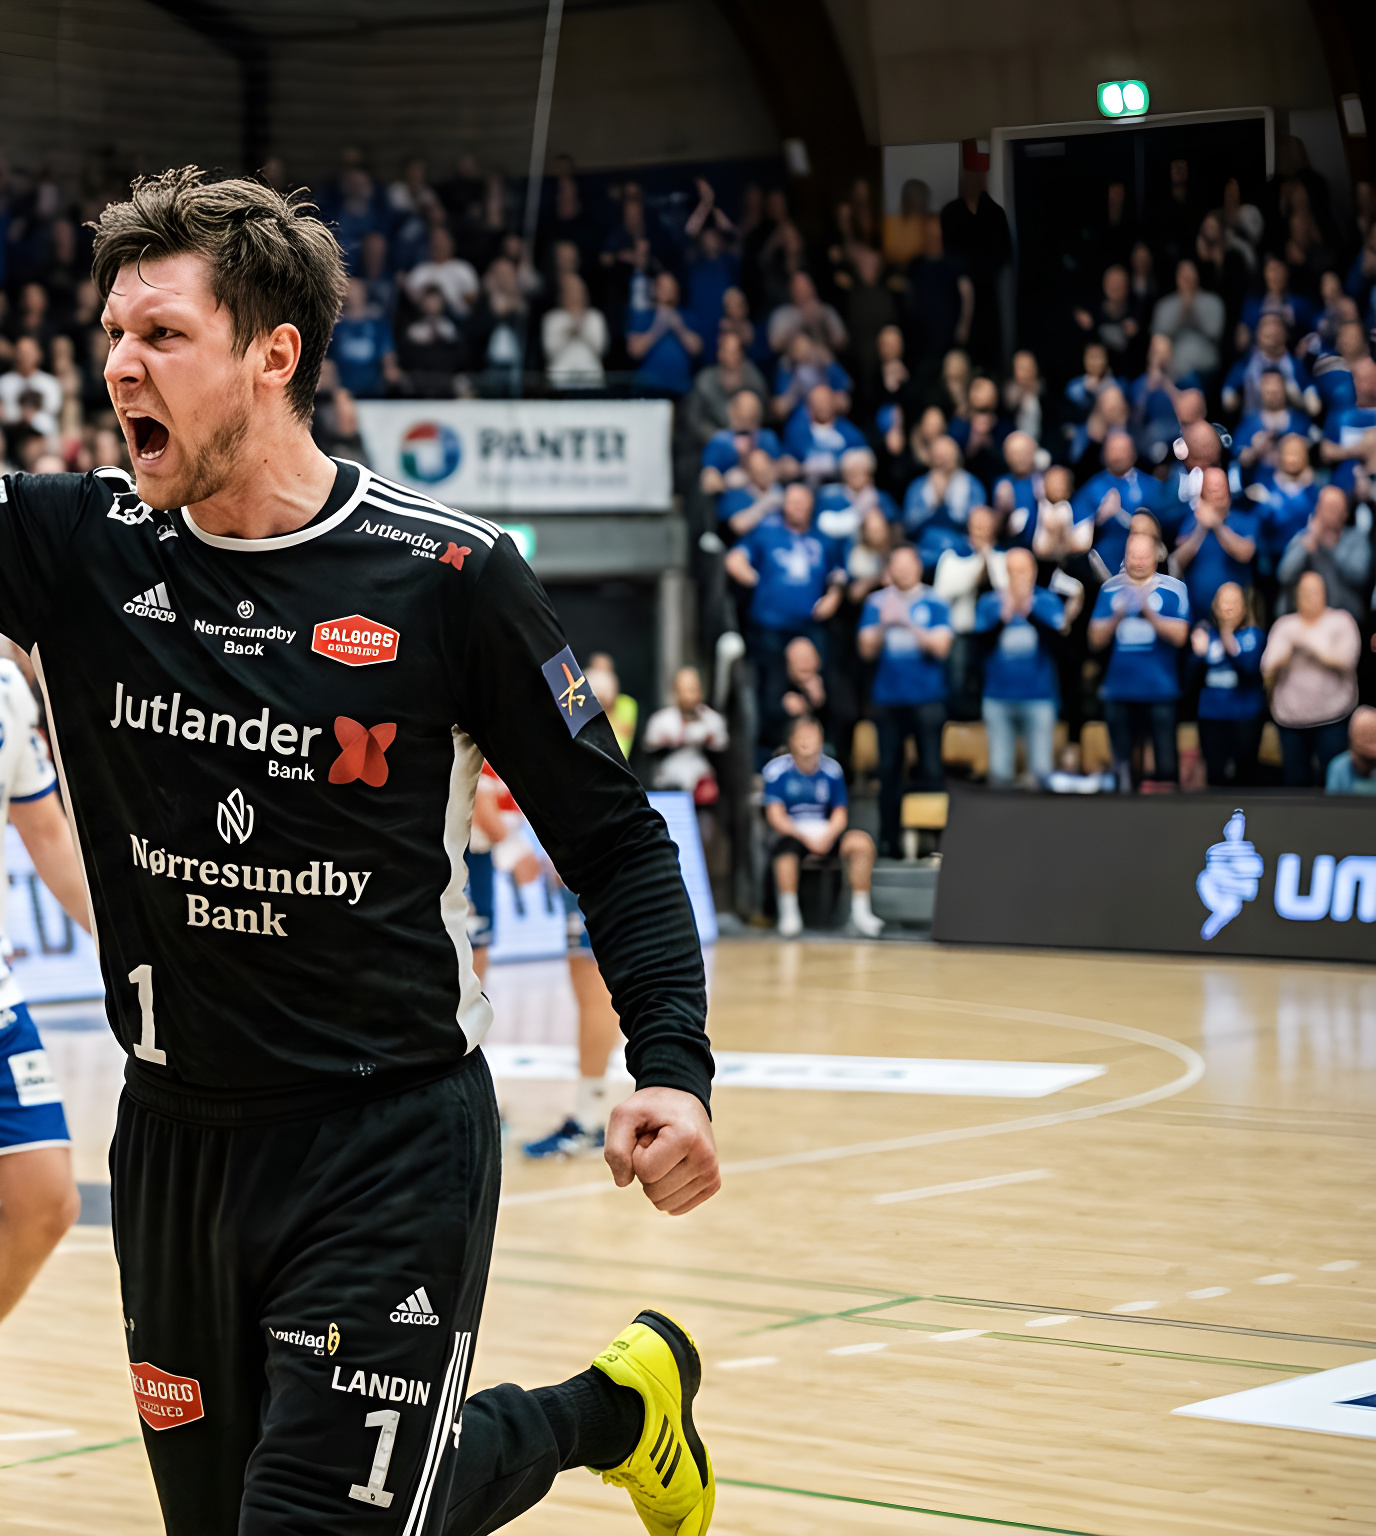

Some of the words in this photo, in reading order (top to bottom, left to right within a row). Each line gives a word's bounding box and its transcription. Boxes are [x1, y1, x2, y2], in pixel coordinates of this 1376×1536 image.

[109, 681, 323, 758] Jutlander
[267, 759, 316, 782] Bank
[129, 833, 373, 905] Nørresundby
[185, 893, 289, 937] Bank
[127, 964, 167, 1067] 1
[330, 1365, 432, 1407] LANDIN
[347, 1408, 402, 1509] 1
